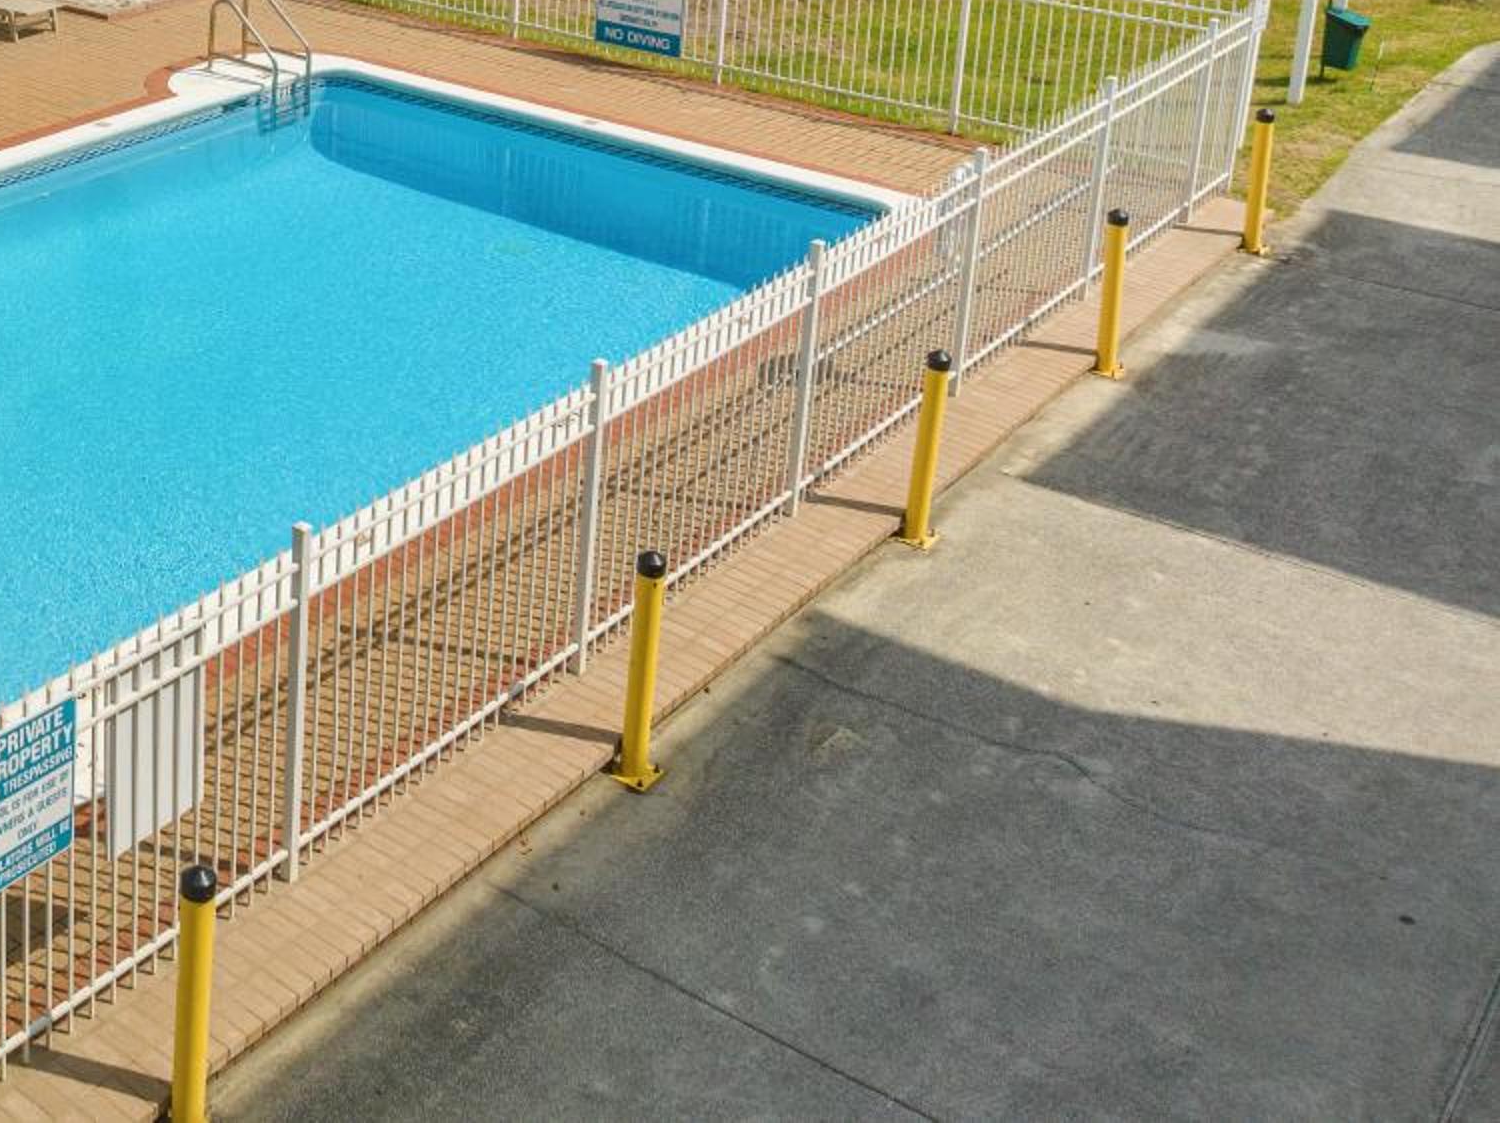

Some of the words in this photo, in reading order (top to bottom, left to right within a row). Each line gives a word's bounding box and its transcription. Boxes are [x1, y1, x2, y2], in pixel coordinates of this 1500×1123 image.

[605, 26, 622, 40] NO
[627, 30, 670, 51] DIVING
[3, 744, 73, 796] TRESPASSING
[35, 826, 56, 848] WILL
